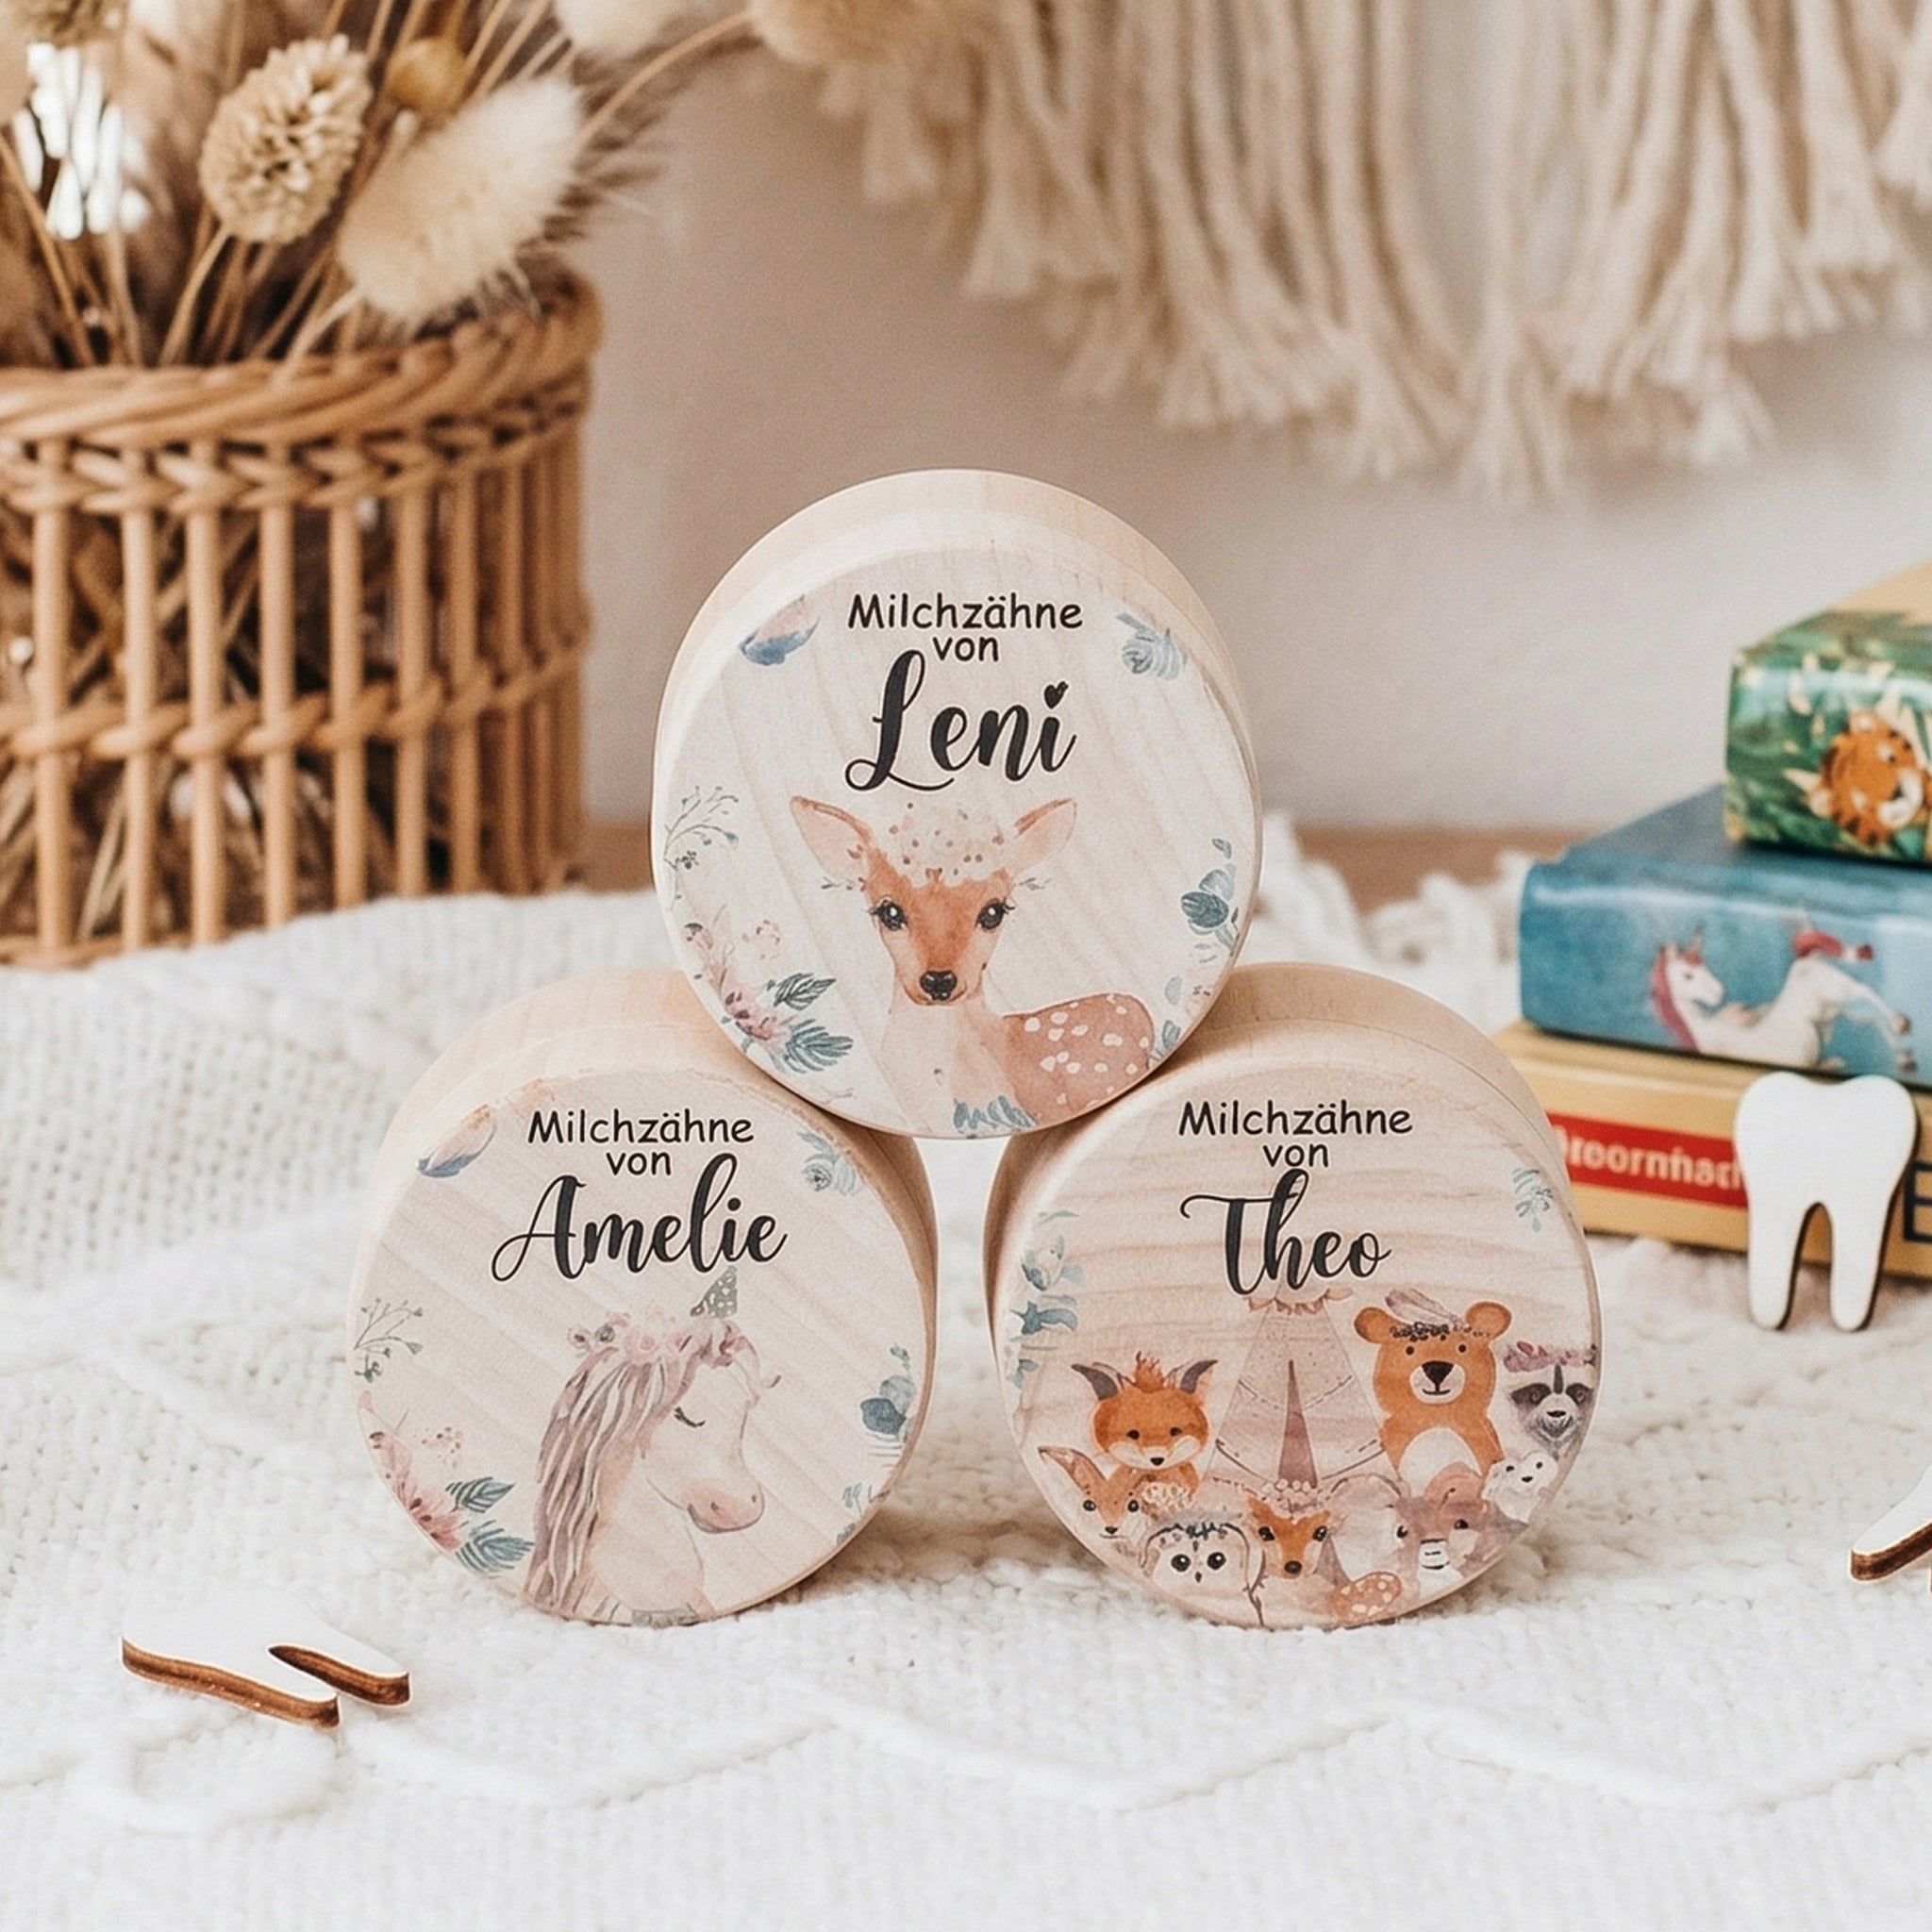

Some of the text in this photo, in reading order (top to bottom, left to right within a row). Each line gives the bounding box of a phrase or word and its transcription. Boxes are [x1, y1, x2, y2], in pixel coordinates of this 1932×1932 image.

[848, 591, 1083, 629] Milchzähne
[932, 636, 999, 662] von
[844, 649, 1077, 791] Leni
[527, 1108, 754, 1143] Milchzähne
[1178, 1098, 1413, 1136] Milchzähne
[606, 1151, 672, 1176] von
[1262, 1143, 1329, 1168] von
[491, 1153, 788, 1282] Amelie
[1179, 1168, 1392, 1295] Theo
